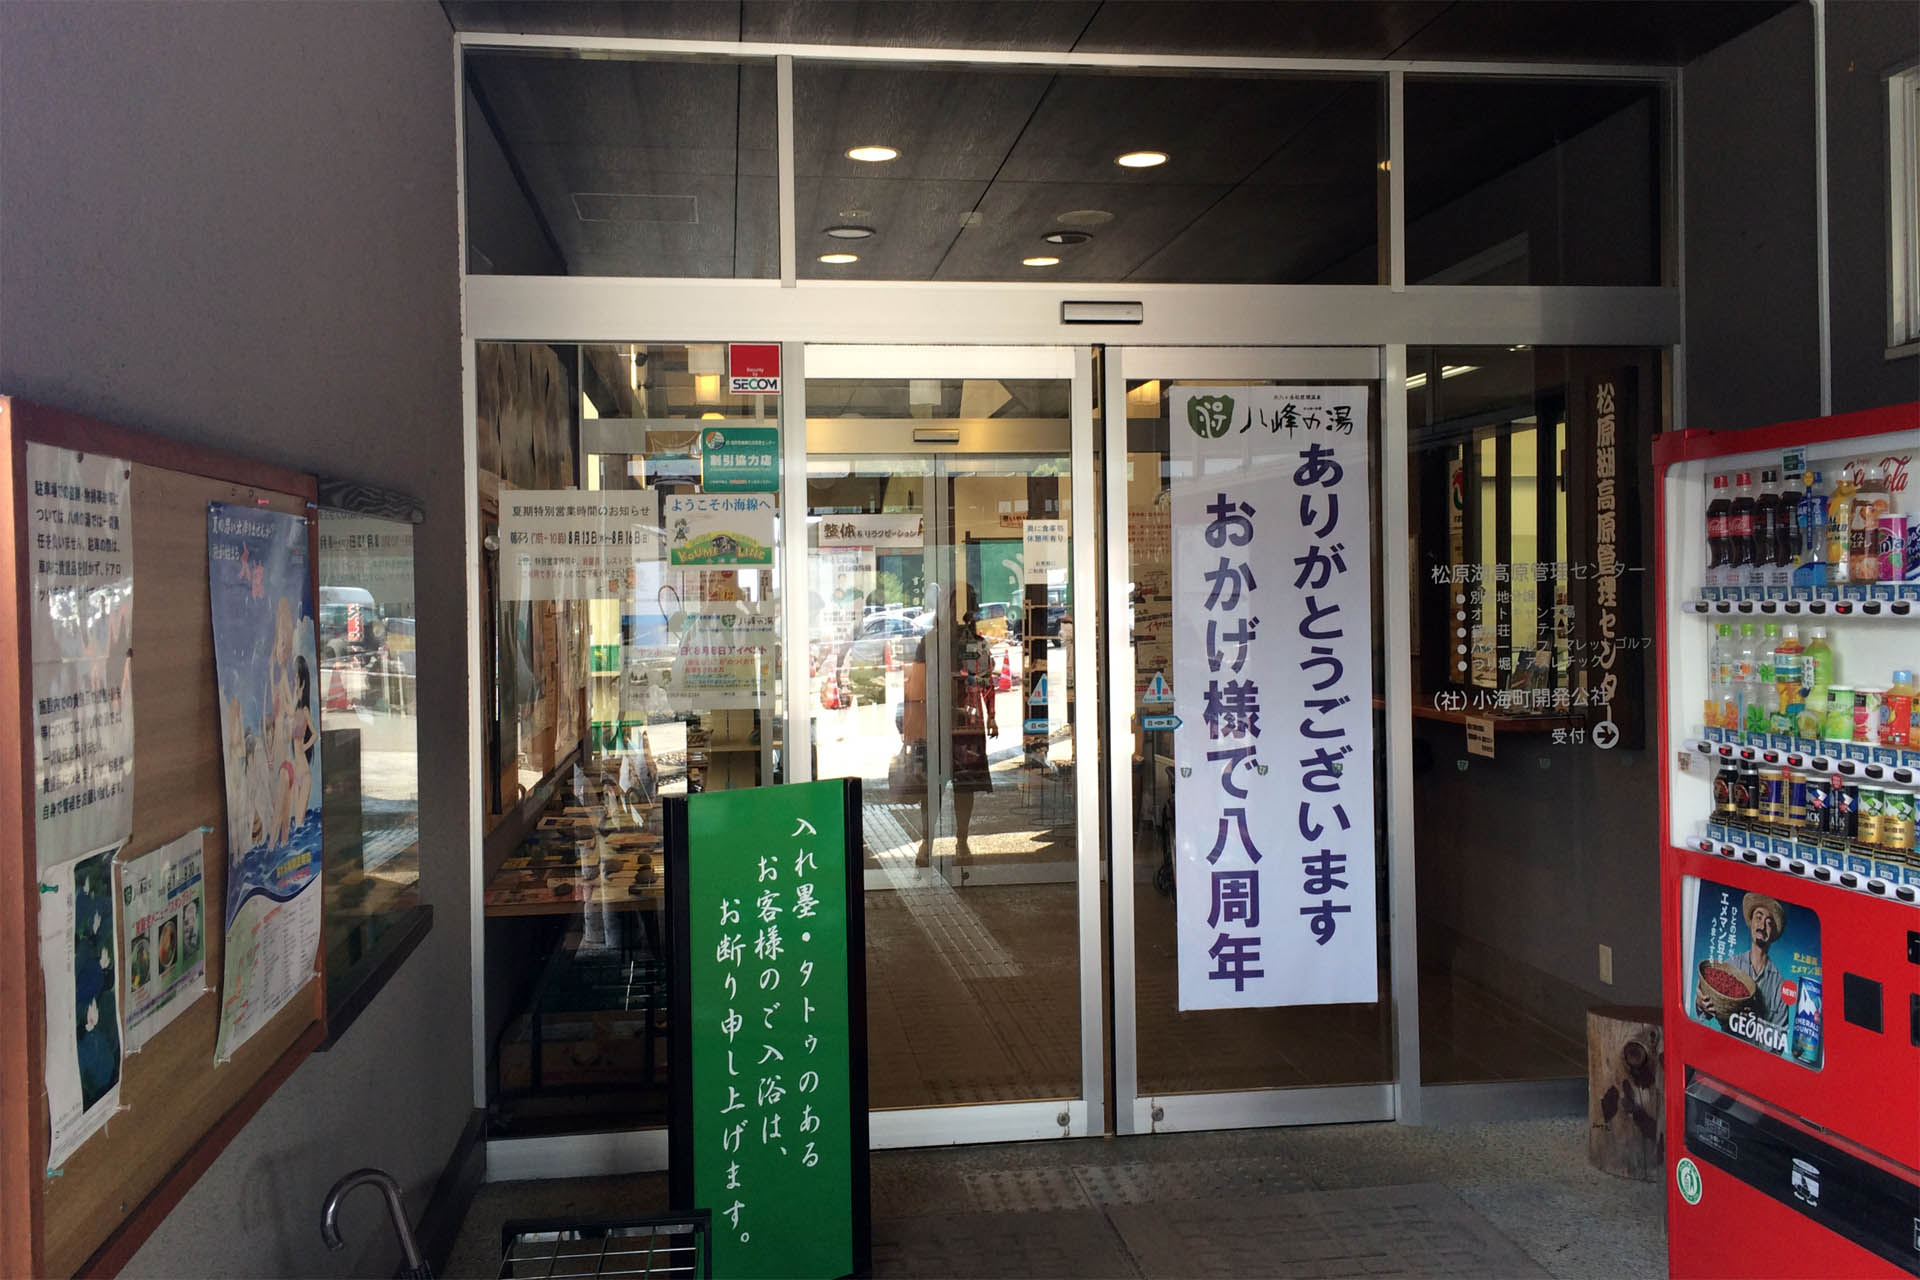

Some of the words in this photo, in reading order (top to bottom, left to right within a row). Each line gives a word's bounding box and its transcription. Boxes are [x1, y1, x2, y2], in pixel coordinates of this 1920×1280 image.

[733, 379, 777, 390] SECOM
[1239, 402, 1354, 440] 八峰の湯
[511, 504, 651, 517] 夏期特別営業時間のお知らせ
[671, 497, 772, 512] ようこそ小海線へ
[1596, 383, 1618, 738] 松原湖高原管理センター
[1878, 534, 1905, 553] nta
[1431, 561, 1647, 585] 松原湖高原管理センター
[1293, 443, 1354, 946] ありがとうございます
[1202, 493, 1265, 993] おかげ様で八周年
[1551, 728, 1586, 745] 受付
[1806, 811, 1821, 824] ACK
[754, 854, 787, 1157] お客様のご入浴は、
[792, 817, 820, 1168] 入れ墨・タトゥのある
[1728, 1012, 1789, 1052] GEORGIA
[716, 898, 750, 1245] お断り申し上げます。
